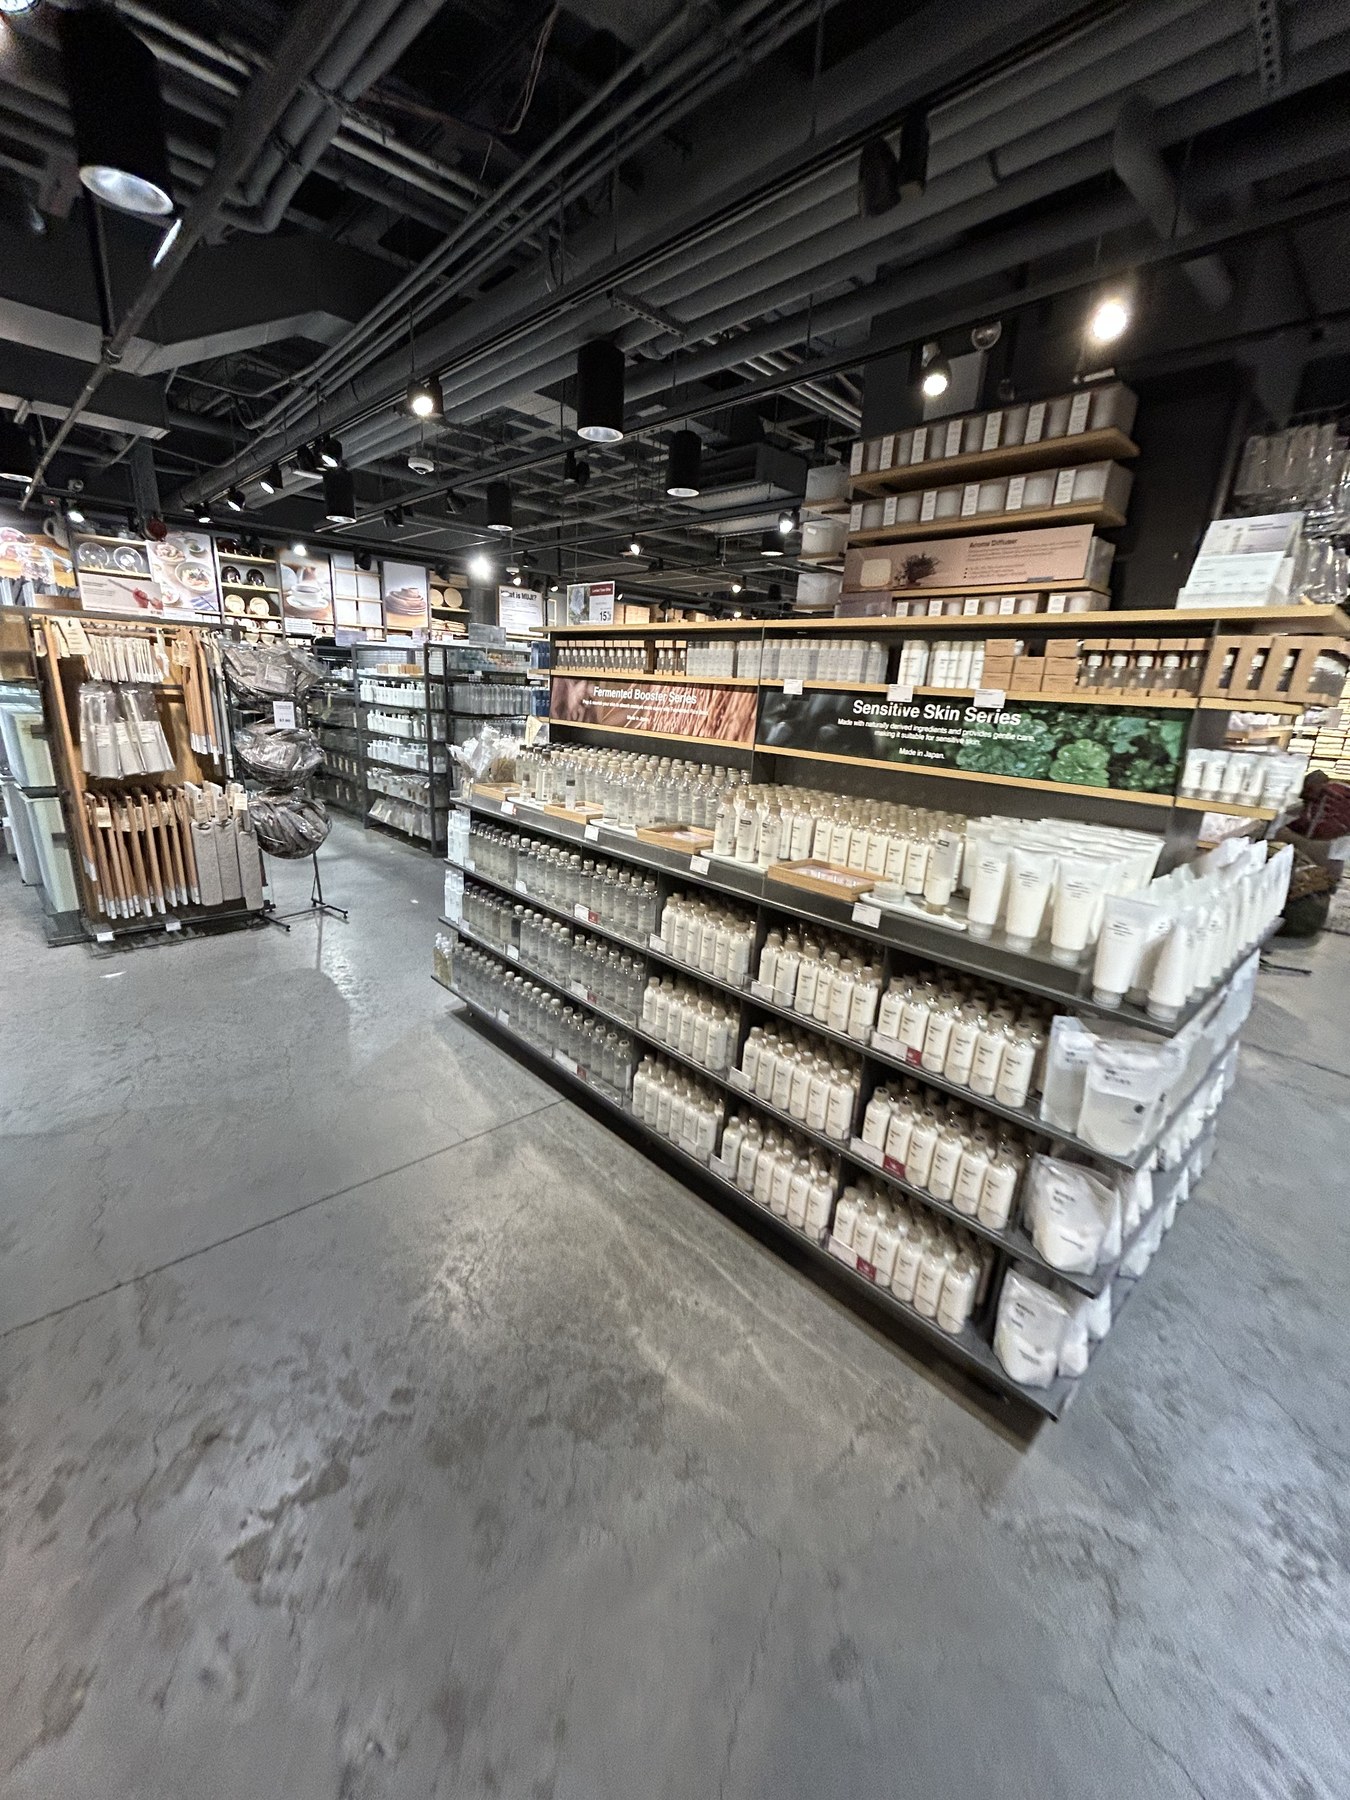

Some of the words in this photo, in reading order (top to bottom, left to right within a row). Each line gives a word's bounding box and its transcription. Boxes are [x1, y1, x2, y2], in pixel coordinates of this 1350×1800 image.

[593, 686, 633, 699] Fermented
[634, 689, 667, 702] Booster
[669, 691, 697, 705] Series
[853, 699, 920, 719] Sensitive
[923, 703, 960, 720] Skin
[964, 706, 1021, 726] Series
[838, 718, 853, 726] Made
[865, 721, 890, 730] naturally
[889, 723, 913, 731] derived
[912, 724, 948, 734] ingredients
[962, 729, 992, 739] provides
[992, 732, 1016, 741] gentle
[874, 730, 896, 739] making
[901, 732, 925, 741] suitable
[925, 733, 935, 741] for
[935, 735, 965, 745] sensitive
[898, 747, 917, 756] Made
[917, 749, 923, 757] in
[923, 750, 945, 760] Japan.
